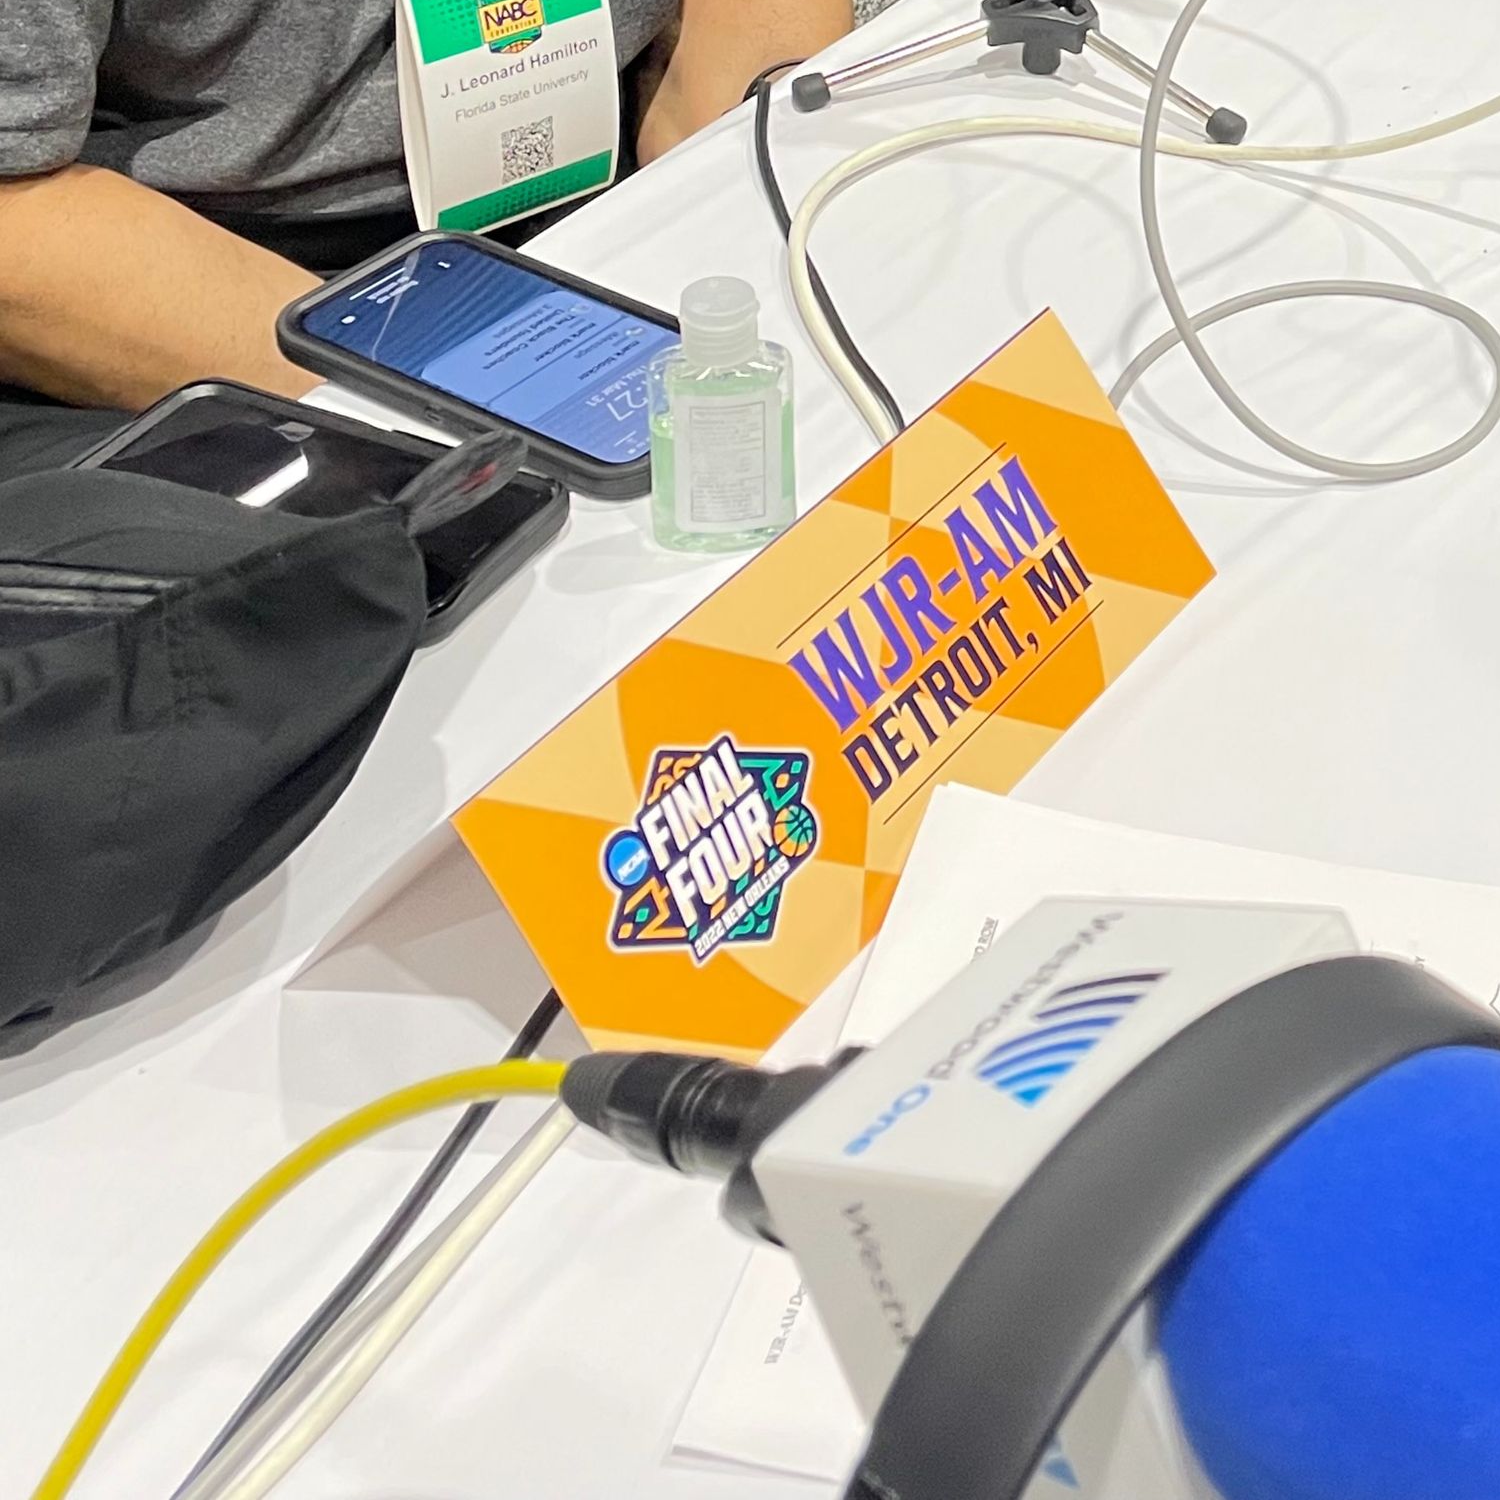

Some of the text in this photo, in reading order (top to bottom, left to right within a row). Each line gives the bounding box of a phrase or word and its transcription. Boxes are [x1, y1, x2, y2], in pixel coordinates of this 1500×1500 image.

[440, 37, 598, 99] J. Leonard Hamilton
[455, 68, 590, 122] Florida State University
[787, 455, 1058, 734] WJR-AM
[842, 537, 1093, 804] DETROIT, MI
[640, 741, 755, 872] FINAL
[666, 789, 775, 928] FOUR
[694, 856, 790, 957] 2022 NEW ORLEANS
[843, 910, 1126, 1157] Westwood One
